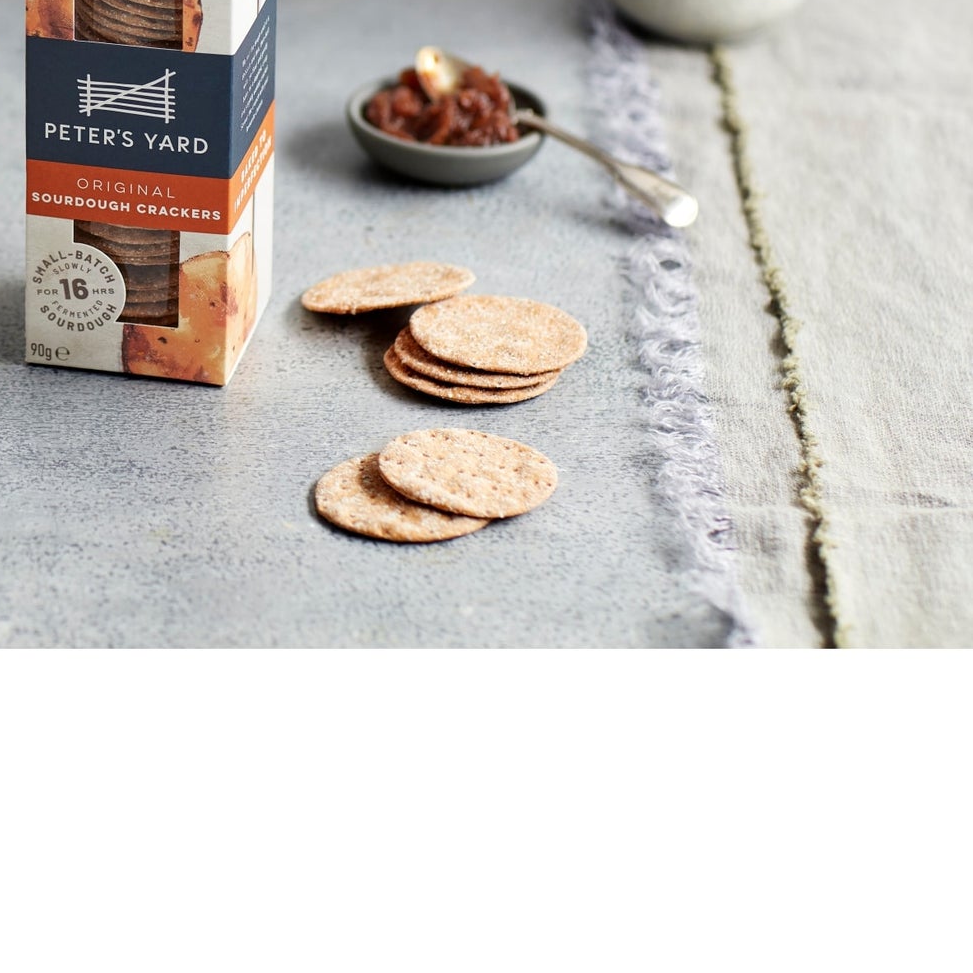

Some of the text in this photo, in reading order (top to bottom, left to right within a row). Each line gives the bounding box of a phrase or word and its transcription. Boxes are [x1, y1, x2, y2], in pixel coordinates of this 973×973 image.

[44, 122, 209, 155] PETER'S YARD
[77, 177, 175, 199] ORIGINAL
[31, 192, 221, 221] SOURDOUGH CRACKERS
[32, 250, 115, 284] SMALL-BATCH
[52, 262, 92, 275] SLOWLY
[59, 278, 89, 300] 16
[40, 303, 117, 332] SOURDOUGH
[51, 299, 103, 319] FERMENTED
[30, 342, 52, 361] 90g
